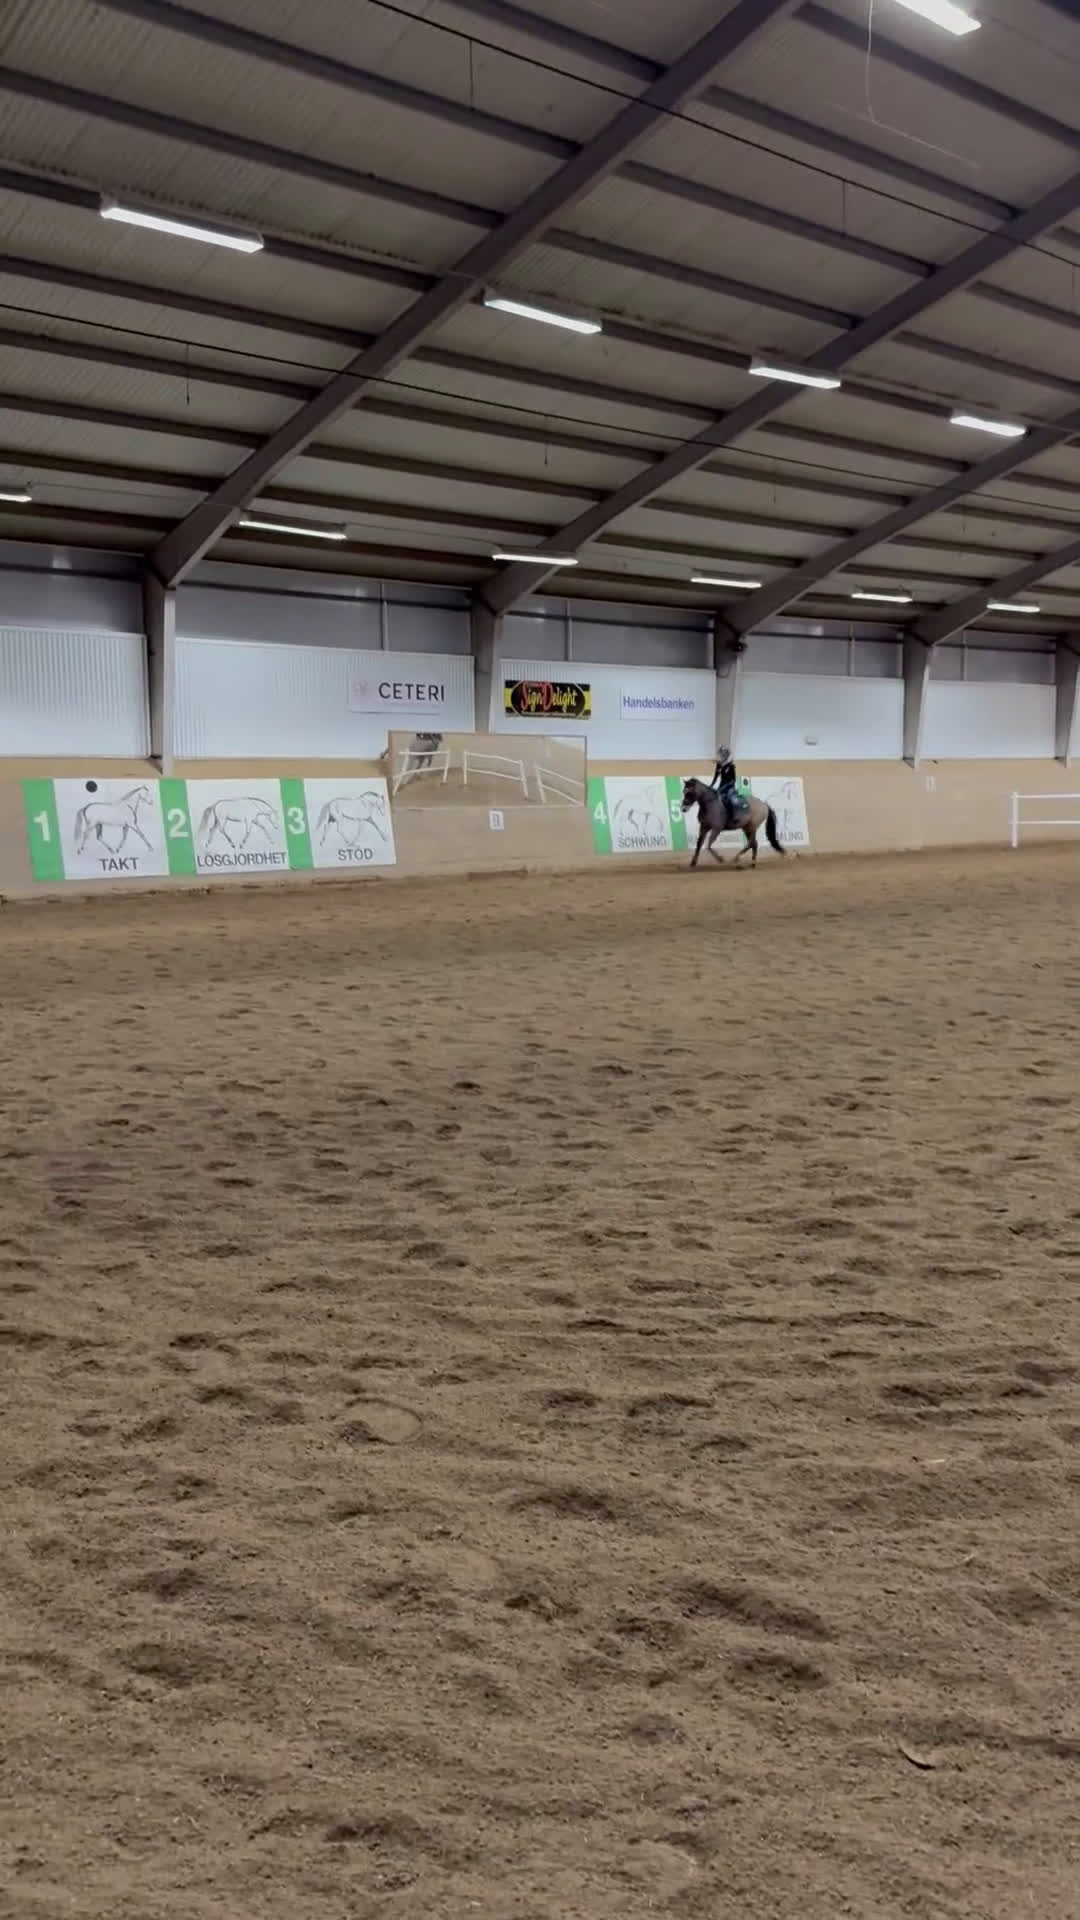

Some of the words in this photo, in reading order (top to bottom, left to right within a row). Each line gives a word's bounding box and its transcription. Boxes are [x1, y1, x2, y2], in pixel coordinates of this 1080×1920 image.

[378, 682, 444, 702] CETERI
[623, 695, 695, 710] Handelsbanken
[287, 807, 306, 835] 3
[593, 801, 607, 824] 4
[671, 799, 683, 822] 5
[33, 810, 51, 842] 1
[167, 808, 189, 838] 2
[617, 834, 667, 848] SCHWUNG
[98, 857, 140, 871] TAKT
